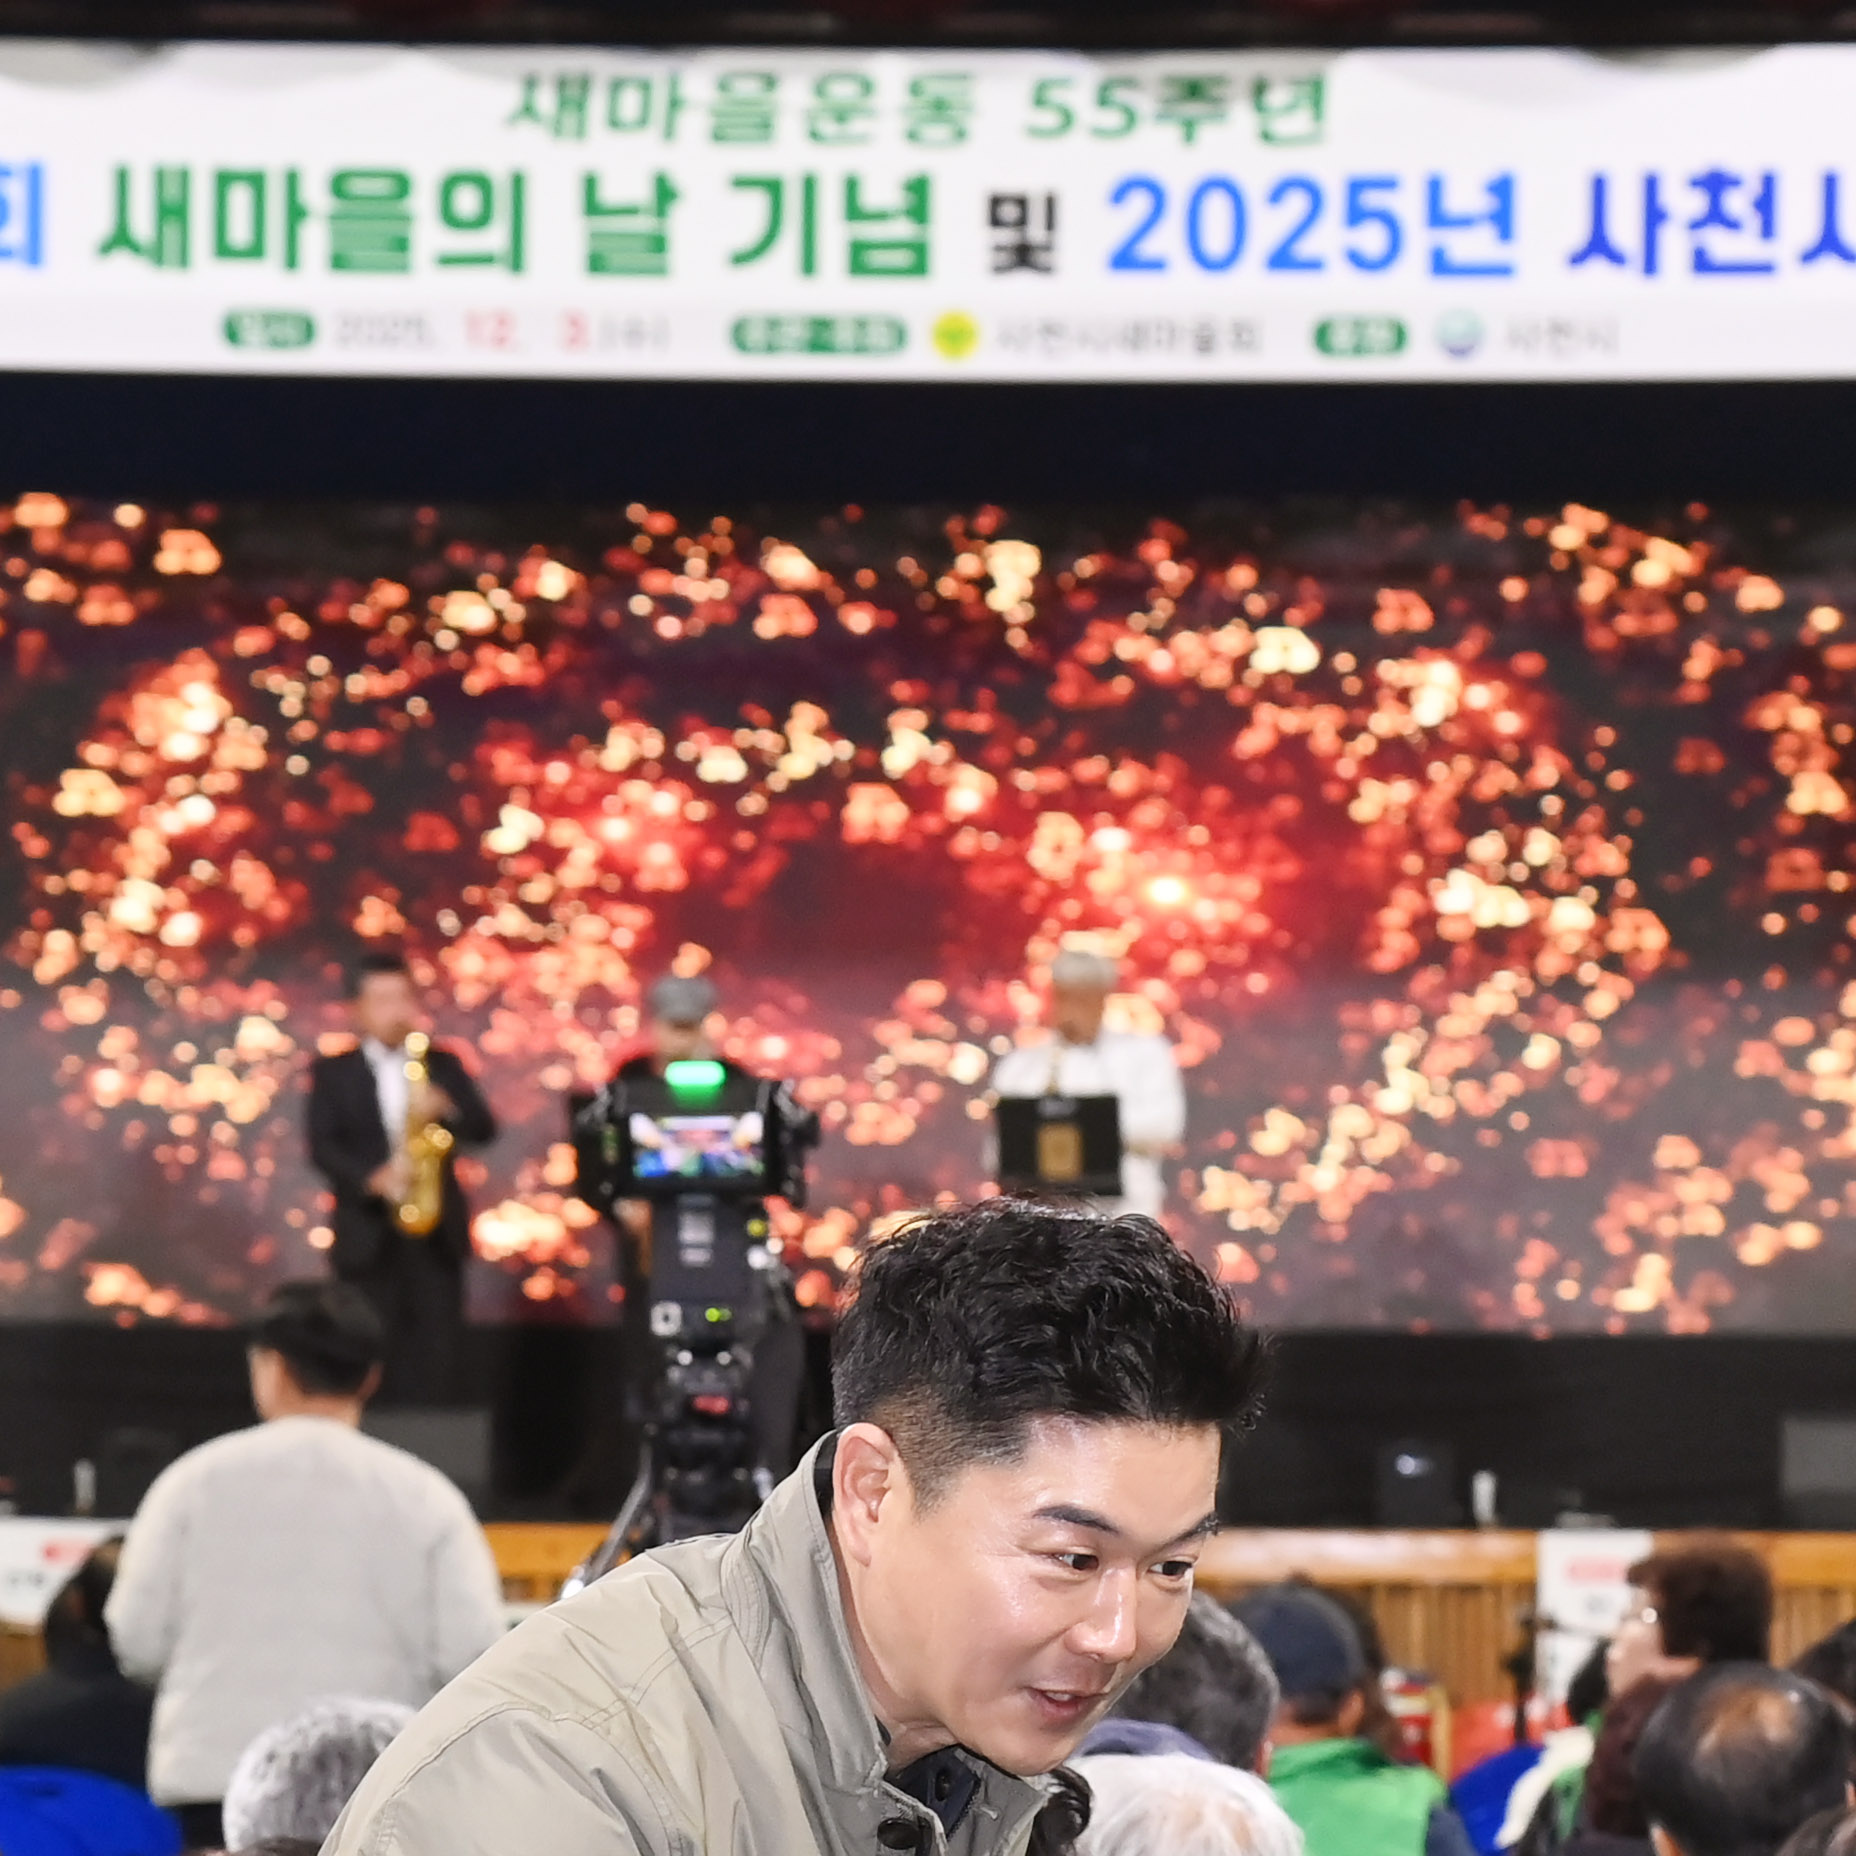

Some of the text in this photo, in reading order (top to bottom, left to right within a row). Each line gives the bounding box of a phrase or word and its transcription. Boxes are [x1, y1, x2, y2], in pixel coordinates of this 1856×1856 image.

[508, 73, 1330, 145] 새마을운동 55주년
[97, 166, 527, 275] 새마을의
[581, 172, 681, 277] 날
[730, 174, 933, 279] 기념
[988, 193, 1057, 275] 및
[1106, 170, 1518, 280] 2025년
